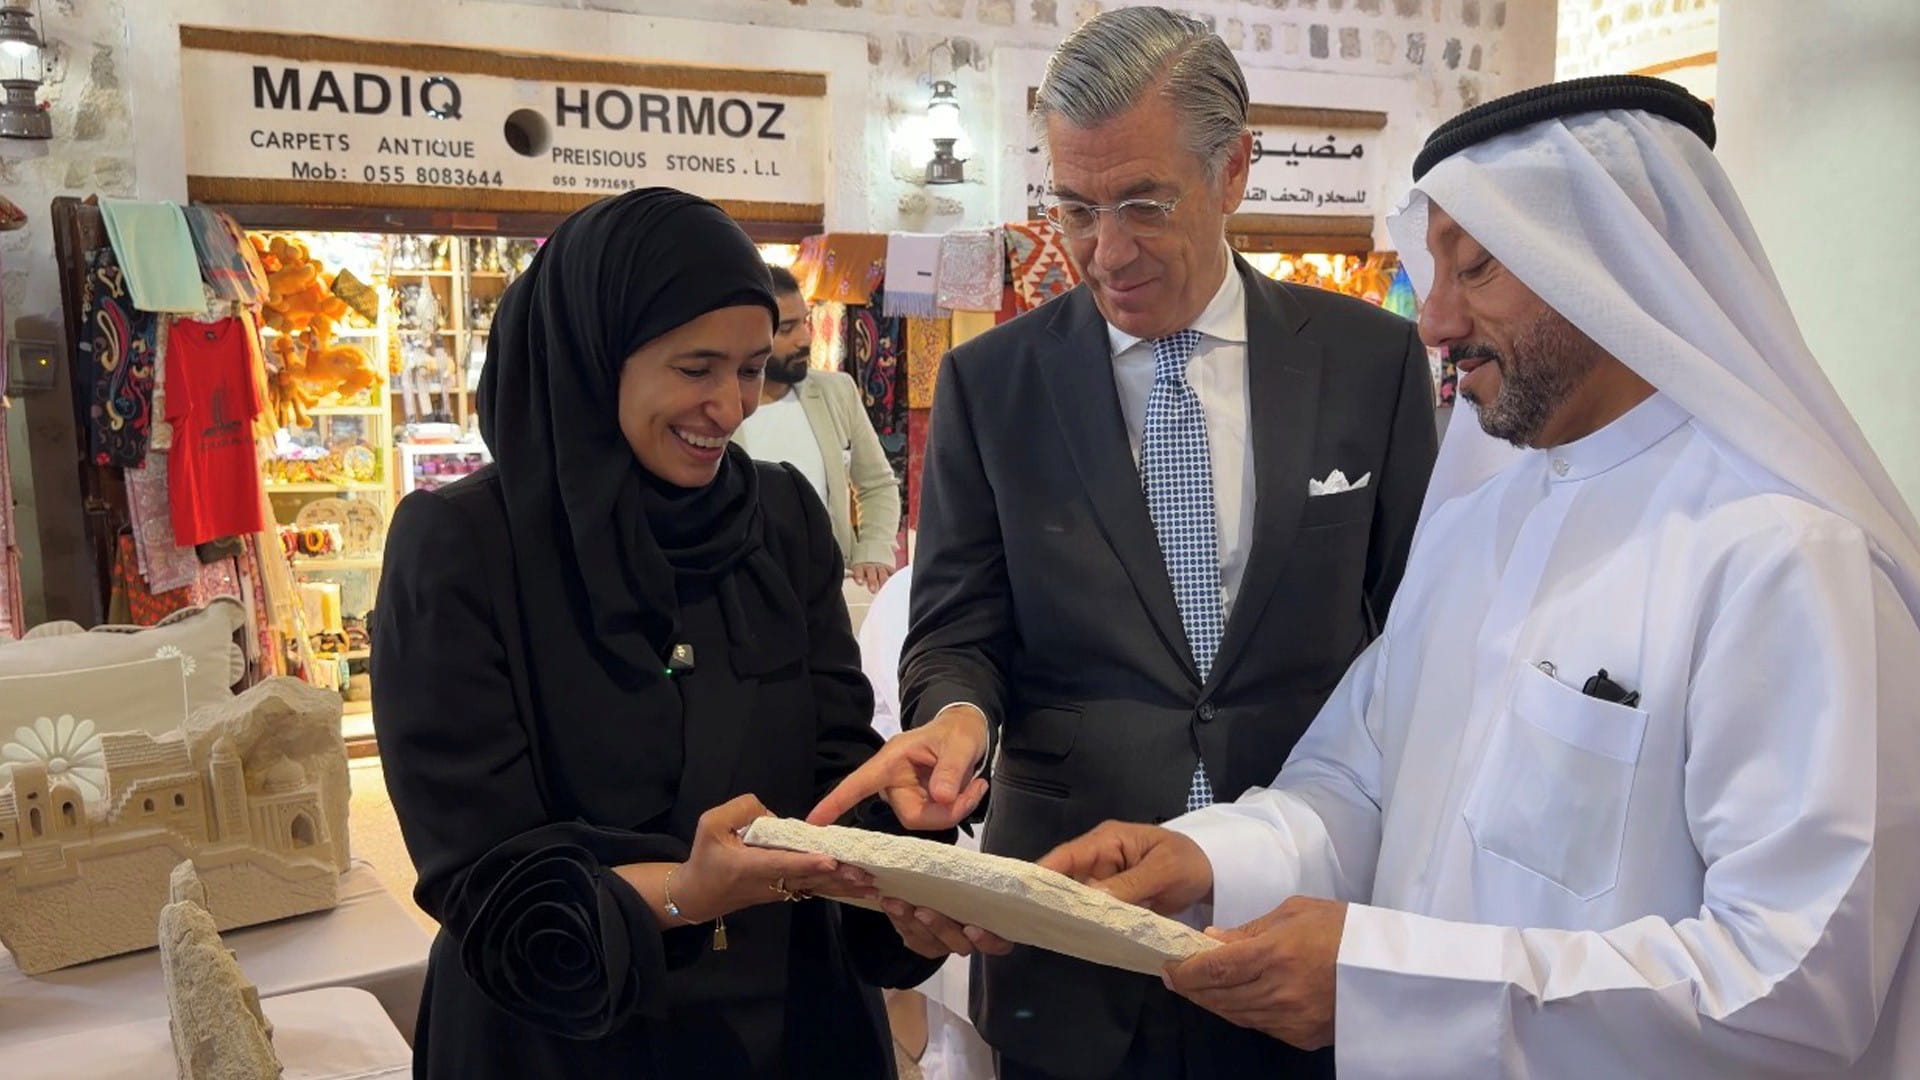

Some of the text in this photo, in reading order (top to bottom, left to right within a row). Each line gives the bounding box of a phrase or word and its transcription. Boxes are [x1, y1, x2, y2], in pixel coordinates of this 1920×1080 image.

[252, 67, 786, 139] MADIQ HORMOZ
[250, 129, 350, 152] CARPETS
[377, 137, 475, 159] ANTIQUE
[551, 147, 647, 169] PREISIOUS
[666, 155, 736, 174] STONES
[1250, 130, 1365, 166] مضيق
[291, 162, 504, 187] Mob: 055 8083644
[552, 175, 577, 187] 050
